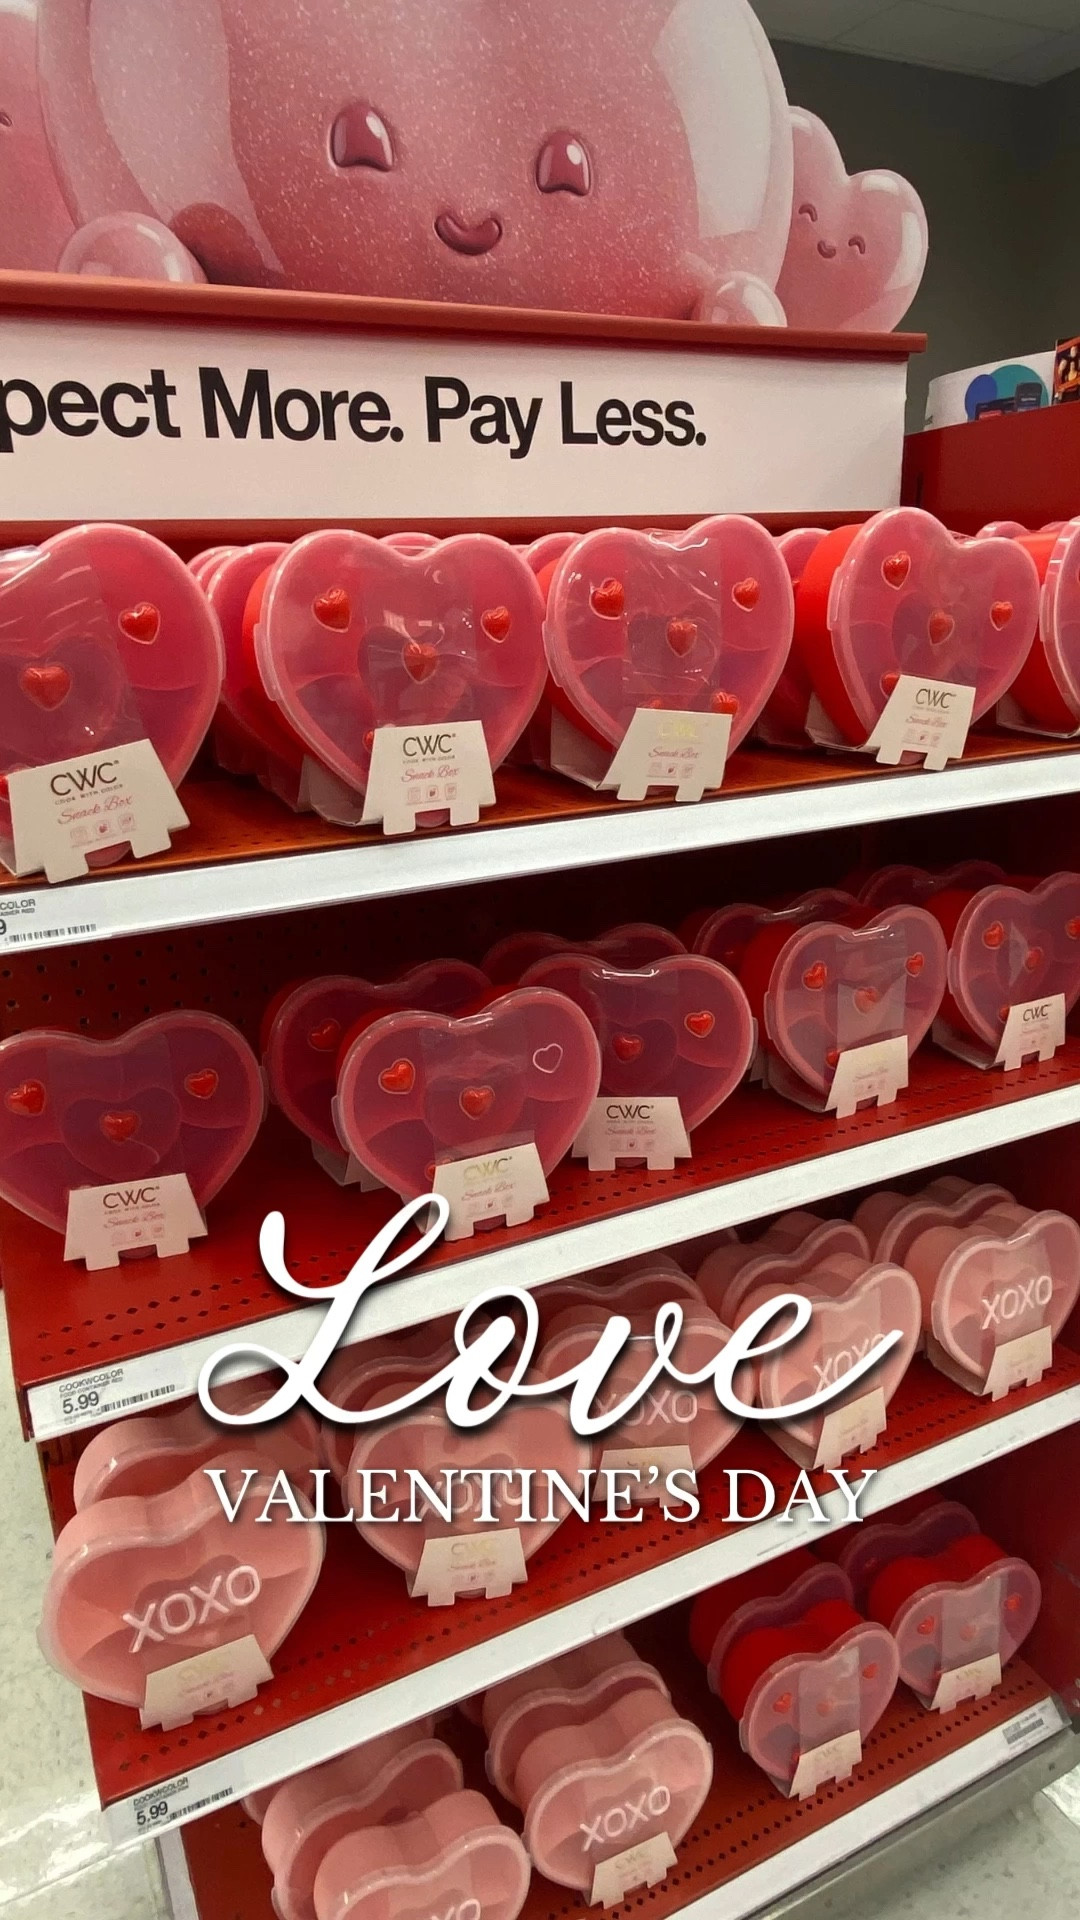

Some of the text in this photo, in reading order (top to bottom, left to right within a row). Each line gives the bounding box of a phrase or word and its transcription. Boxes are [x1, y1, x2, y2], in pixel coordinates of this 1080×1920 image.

[199, 367, 404, 442] More.
[425, 376, 543, 459] Pay
[561, 381, 706, 447] Less.
[58, 795, 134, 824] Snack Box
[982, 1275, 1052, 1330] XOXO
[59, 1368, 123, 1392] COOKWCOLOR
[63, 1391, 99, 1414] 5.99
[122, 1565, 261, 1653] XOXO
[137, 1801, 168, 1825] 5.99
[580, 1786, 671, 1851] XOXO
